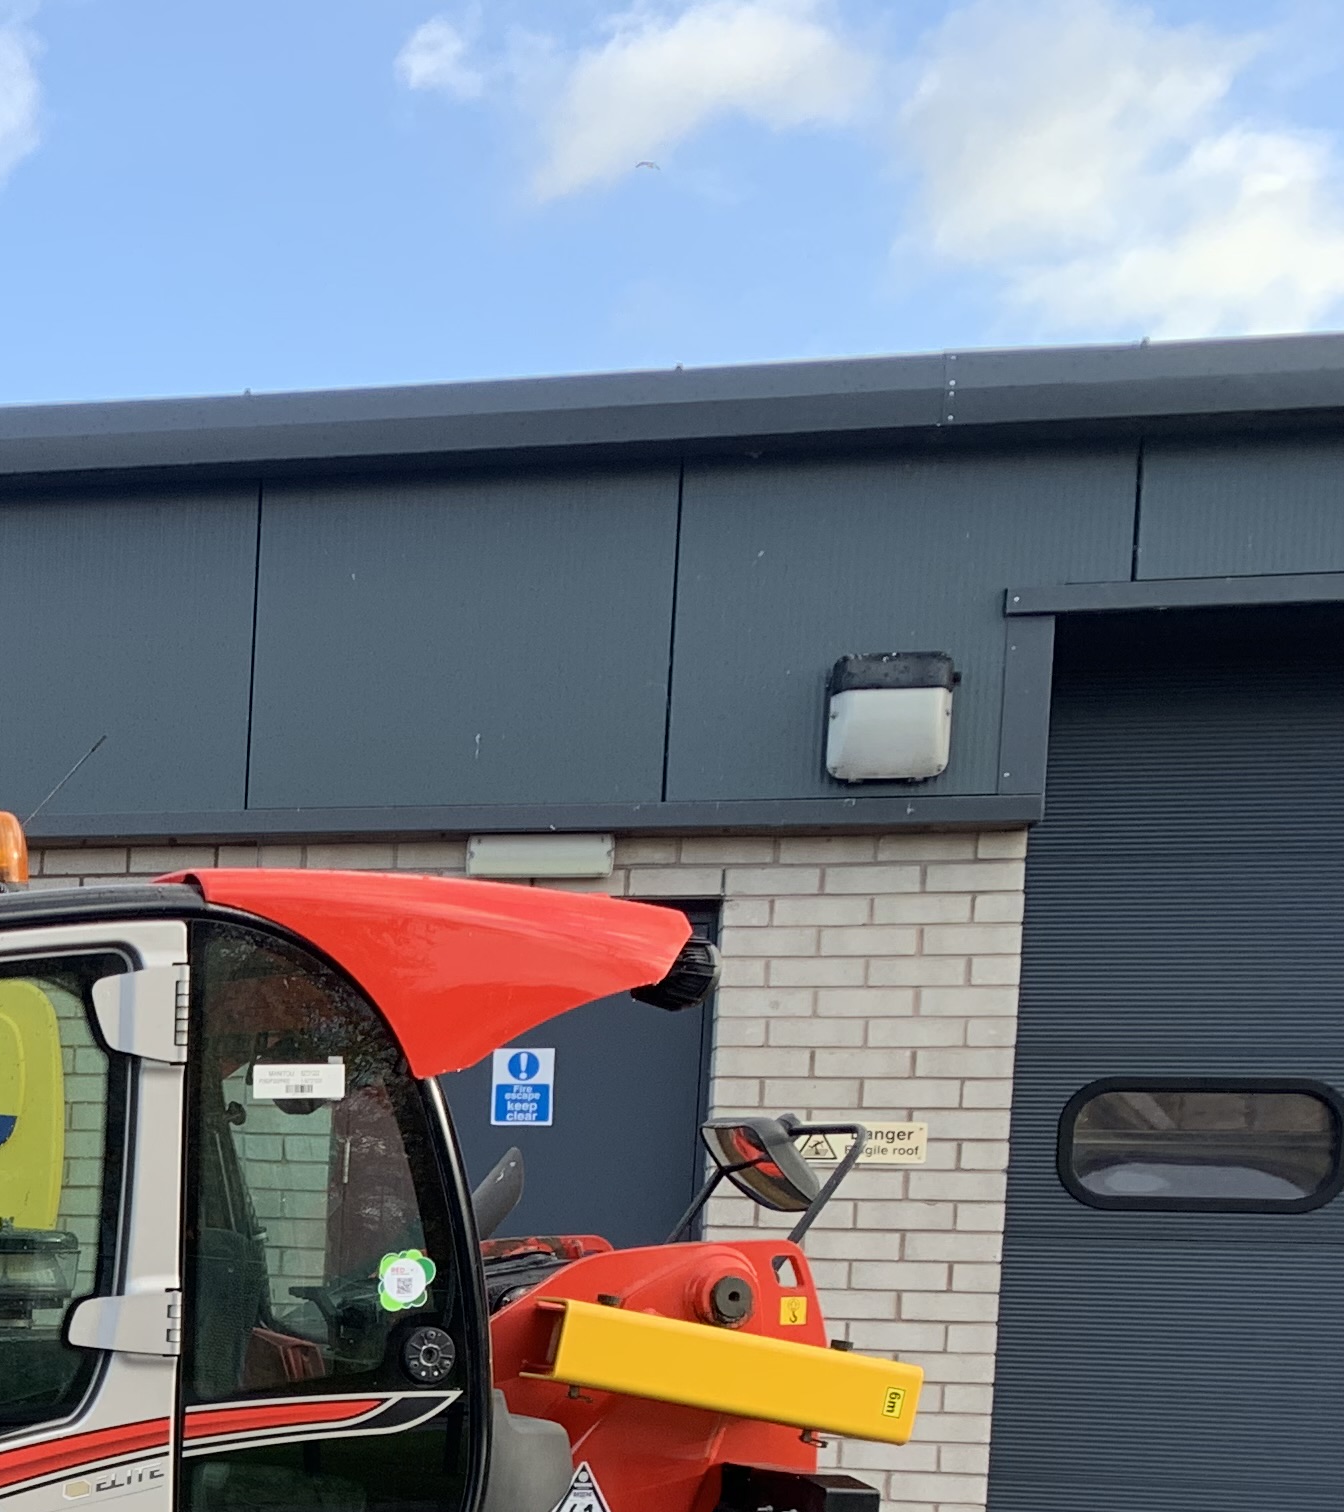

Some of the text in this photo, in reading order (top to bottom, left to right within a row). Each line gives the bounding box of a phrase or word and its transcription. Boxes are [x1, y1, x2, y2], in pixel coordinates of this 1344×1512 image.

[513, 1084, 533, 1093] Fire
[504, 1092, 541, 1101] escape
[507, 1100, 538, 1113] keep
[506, 1111, 538, 1121] clear
[852, 1130, 915, 1144] anger
[844, 1145, 920, 1157] Fgile roof
[885, 1391, 902, 1414] 6m
[96, 1463, 165, 1493] ELITE
